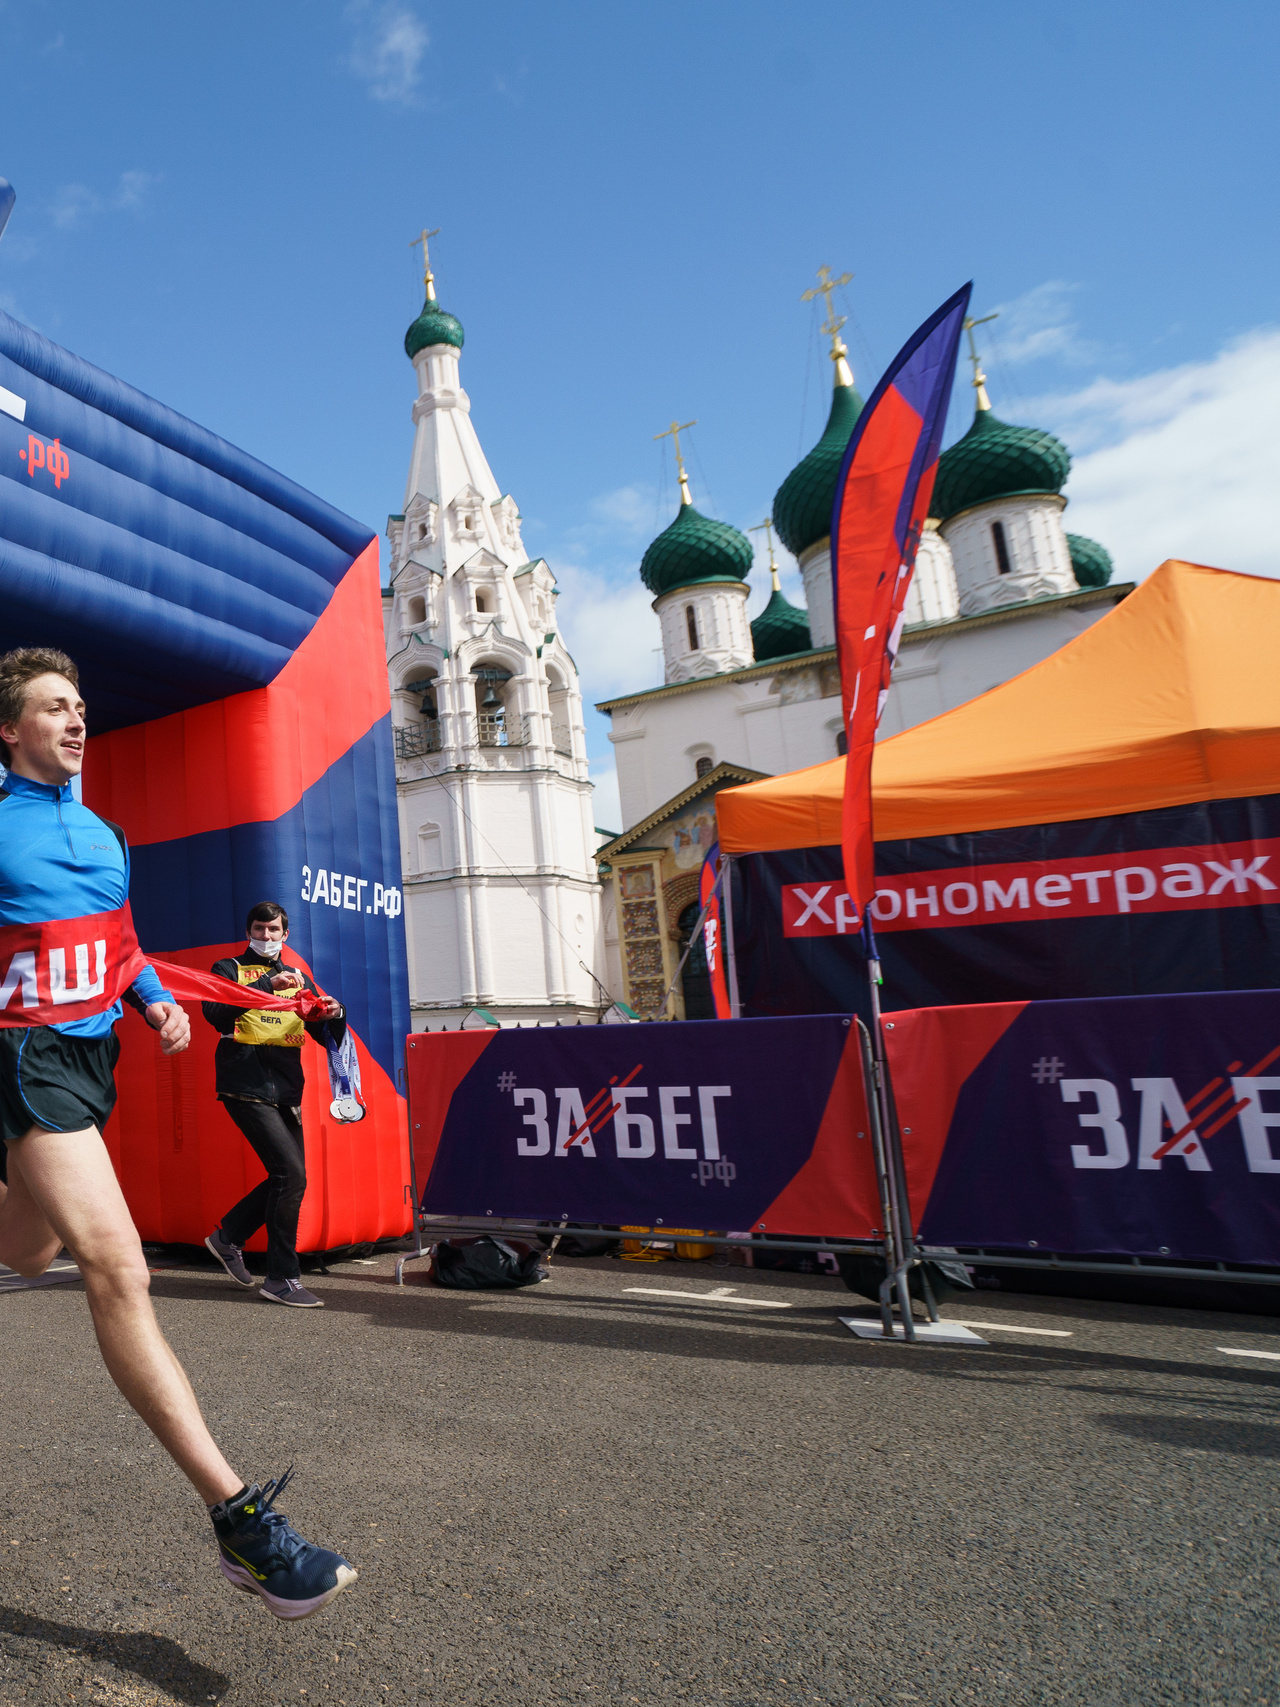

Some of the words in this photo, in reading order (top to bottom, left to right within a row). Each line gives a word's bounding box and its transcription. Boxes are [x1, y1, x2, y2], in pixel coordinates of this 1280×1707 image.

[301, 865, 402, 919] ЗАБЕГ.РФ
[792, 855, 1278, 934] Хронометраж
[261, 1016, 282, 1025] БЕГА
